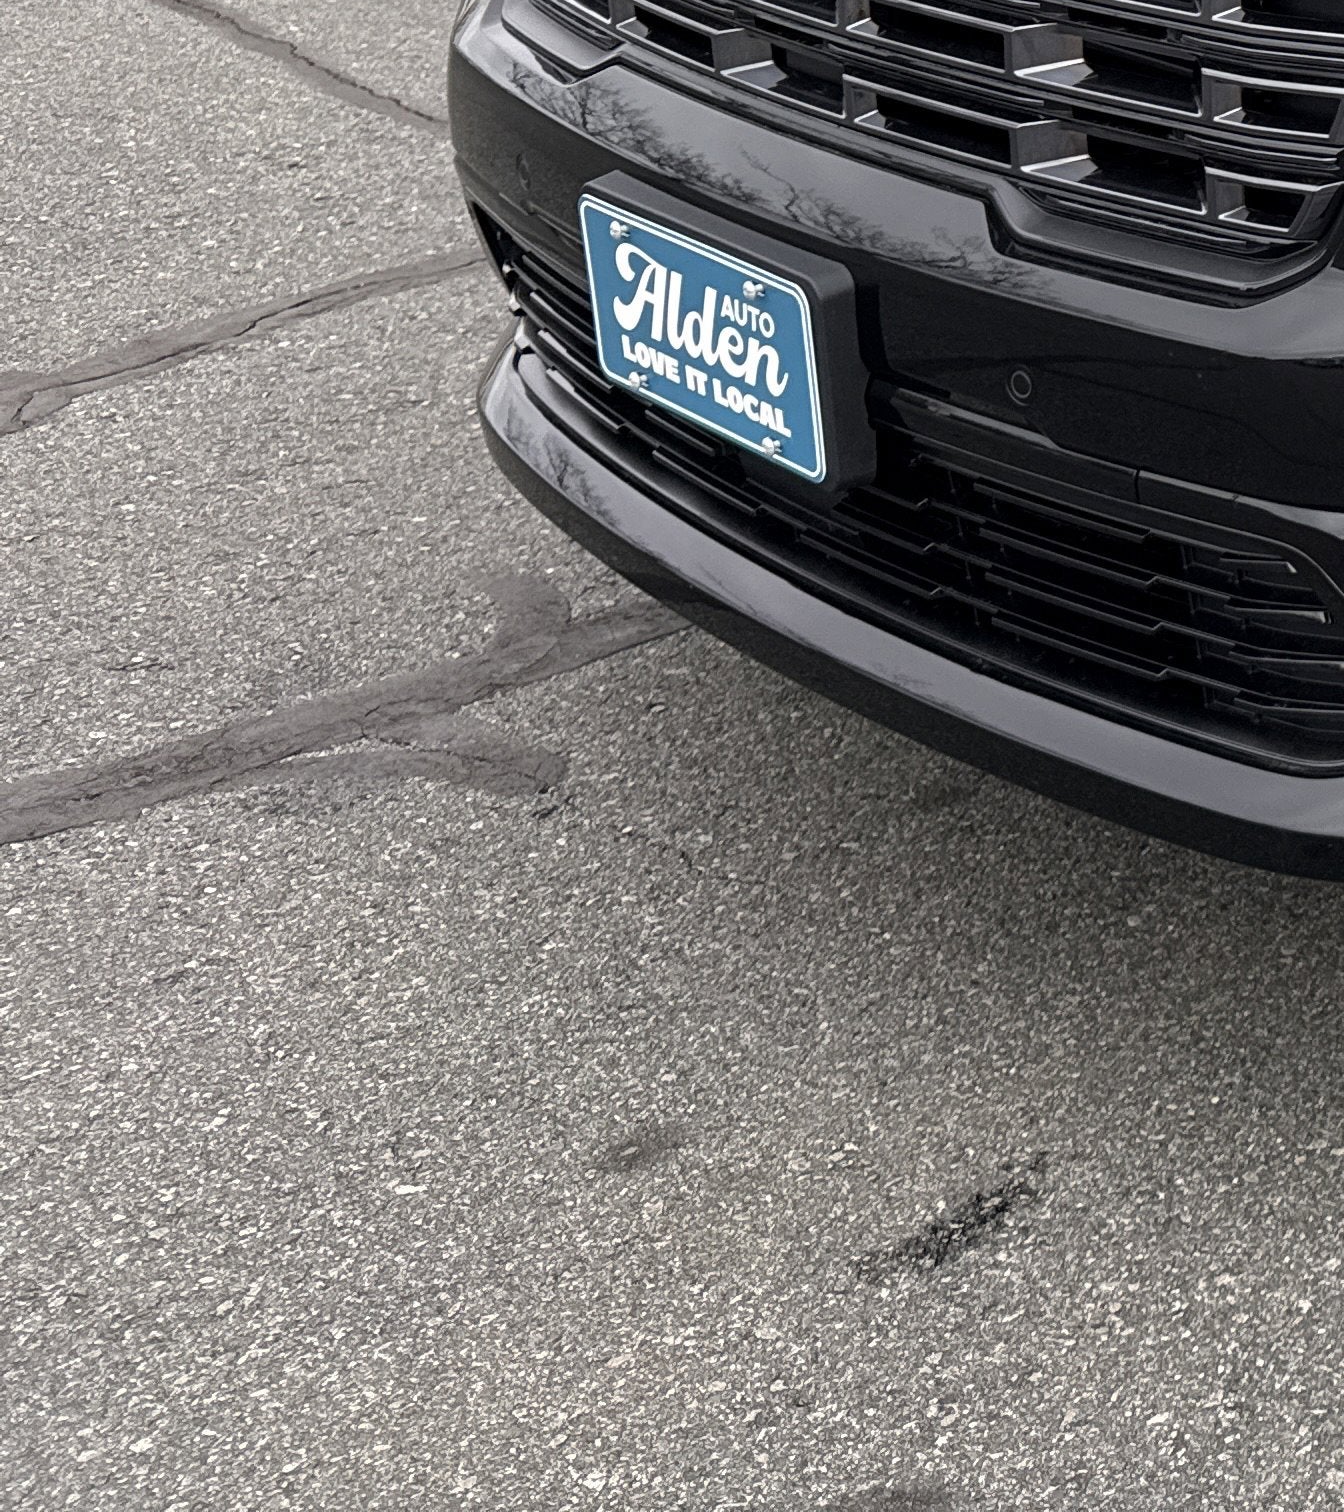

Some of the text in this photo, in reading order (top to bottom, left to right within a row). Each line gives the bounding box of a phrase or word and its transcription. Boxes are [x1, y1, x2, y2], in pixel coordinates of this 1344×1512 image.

[613, 242, 789, 397] Alden
[720, 294, 776, 338] AUTO
[620, 334, 792, 438] LOVE IT LOCAL
